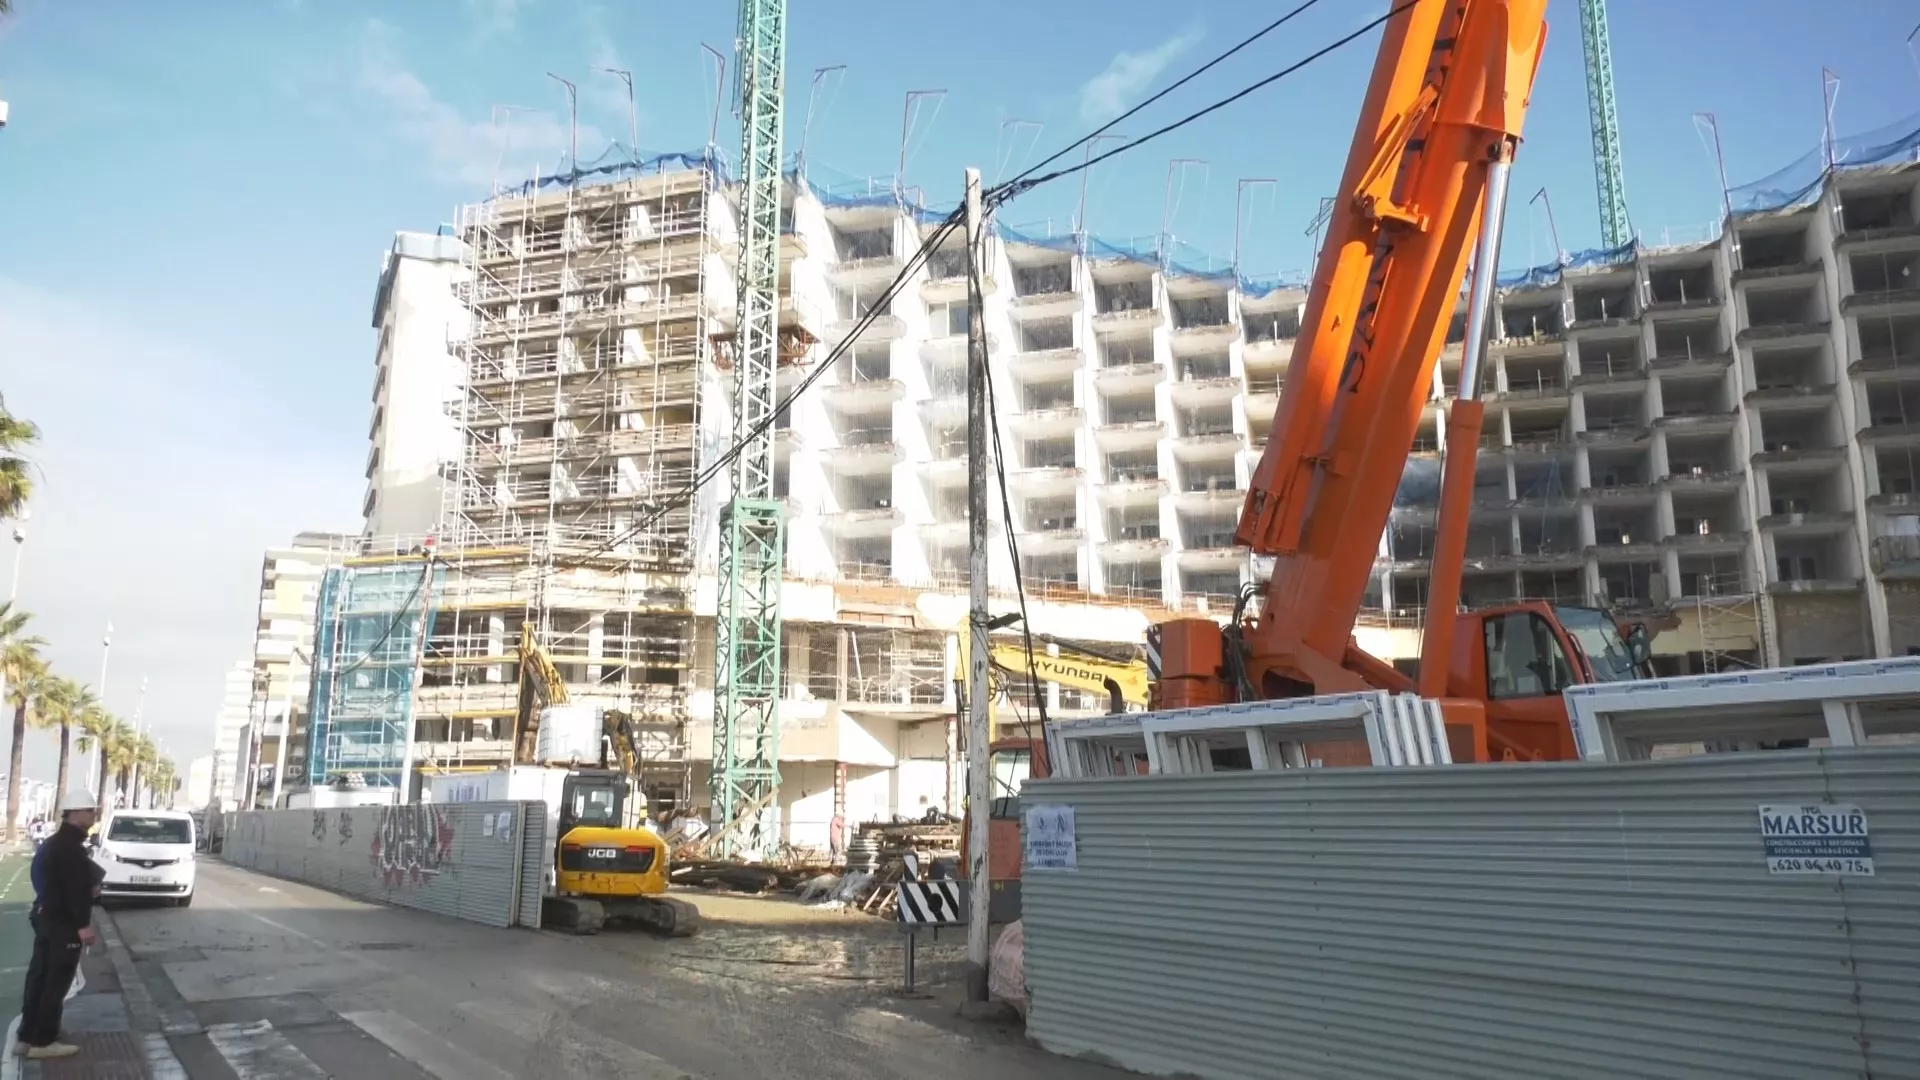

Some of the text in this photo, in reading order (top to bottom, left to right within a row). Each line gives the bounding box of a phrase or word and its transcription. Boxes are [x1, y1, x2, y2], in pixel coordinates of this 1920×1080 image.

[1763, 814, 1865, 834] MARSUR
[588, 849, 616, 858] JCB
[1778, 859, 1801, 870] 620
[1825, 859, 1842, 871] 40
